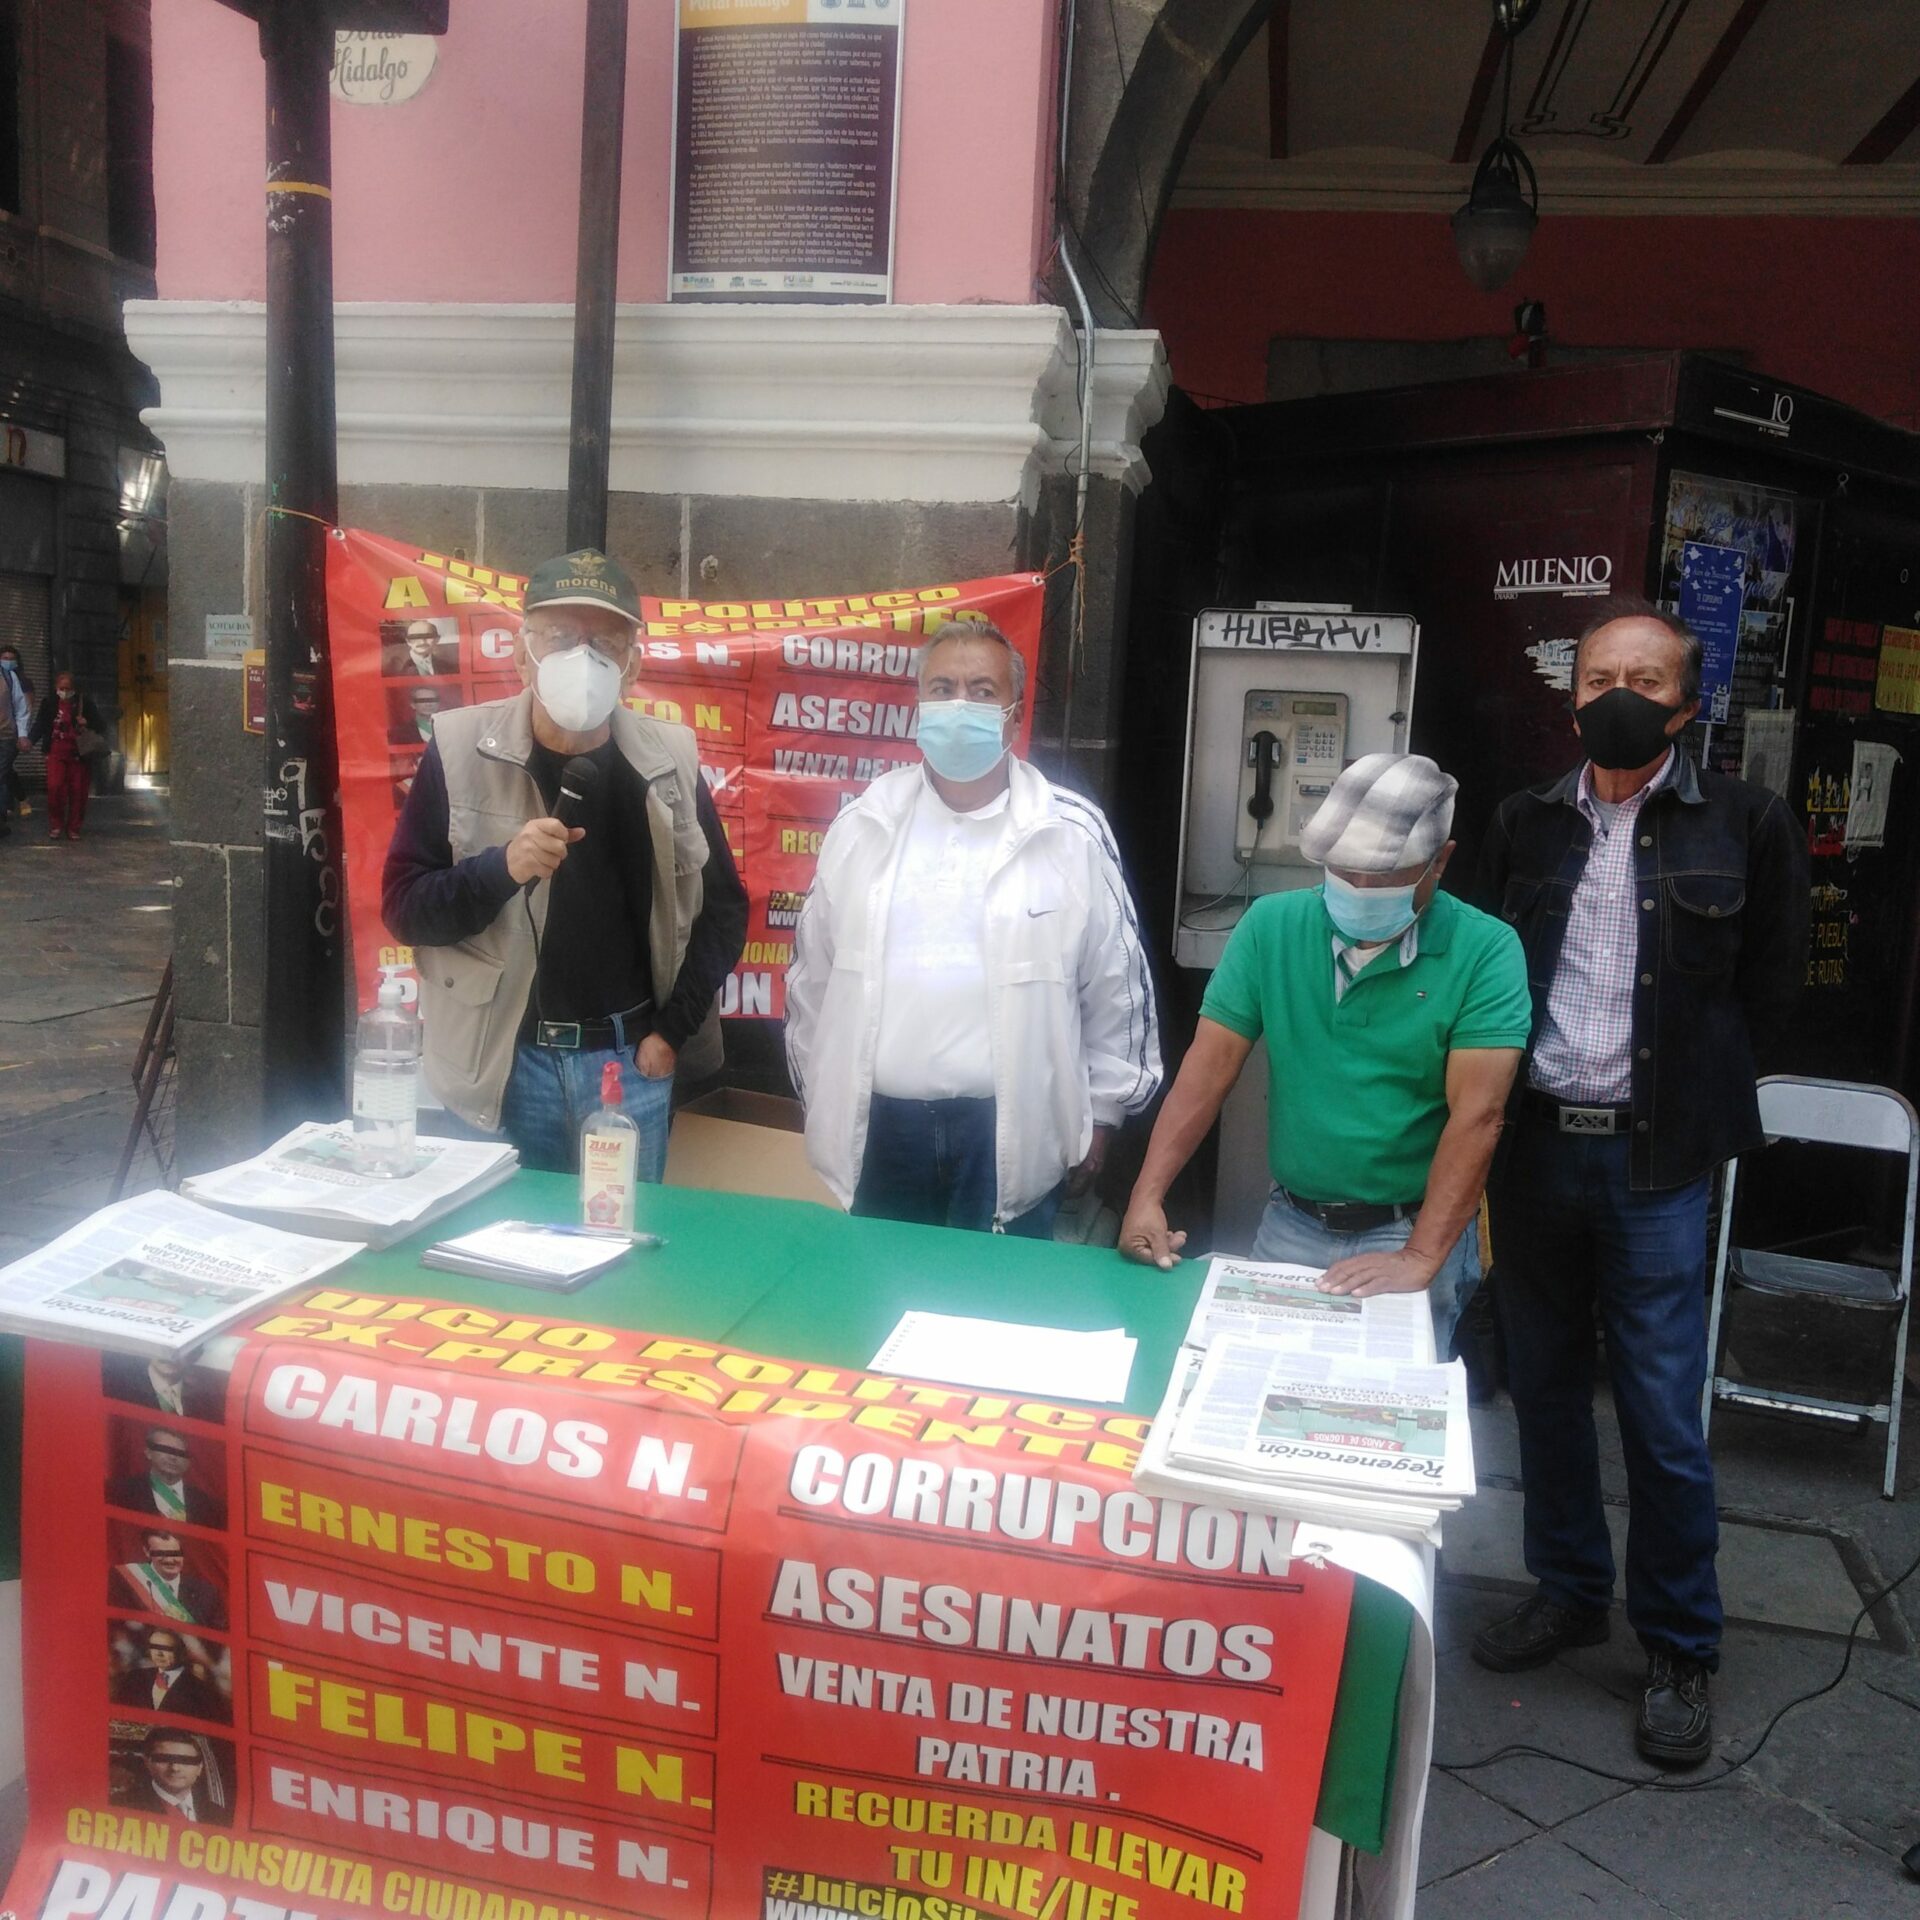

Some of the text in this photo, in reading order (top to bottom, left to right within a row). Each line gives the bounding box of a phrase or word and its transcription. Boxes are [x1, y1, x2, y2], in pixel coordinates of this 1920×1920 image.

[331, 47, 411, 100] Hidalgo
[385, 576, 430, 609] A
[556, 577, 617, 597] morena
[1496, 555, 1612, 587] MILENIO
[696, 642, 741, 667] N.
[695, 704, 732, 732] N.
[774, 749, 848, 780] VENTA
[42, 1298, 194, 1333] Regeneración
[263, 1364, 708, 1502] CARLOS N.
[1258, 1443, 1445, 1478] Regeneración
[260, 1481, 694, 1617] ERNESTO N.
[264, 1580, 701, 1710] VICENTE N.
[769, 1559, 1275, 1682] ASESINATOS
[268, 1664, 713, 1810] FELIPE N.
[777, 1652, 1265, 1772] VENTA DE NUESTRA
[270, 1766, 689, 1889] ENRIQUE N.
[795, 1781, 1248, 1915] RECUERDA LLEVAR
[66, 1808, 169, 1861] GRAN
[179, 1830, 343, 1907] CONSULTA
[890, 1845, 953, 1889] TU
